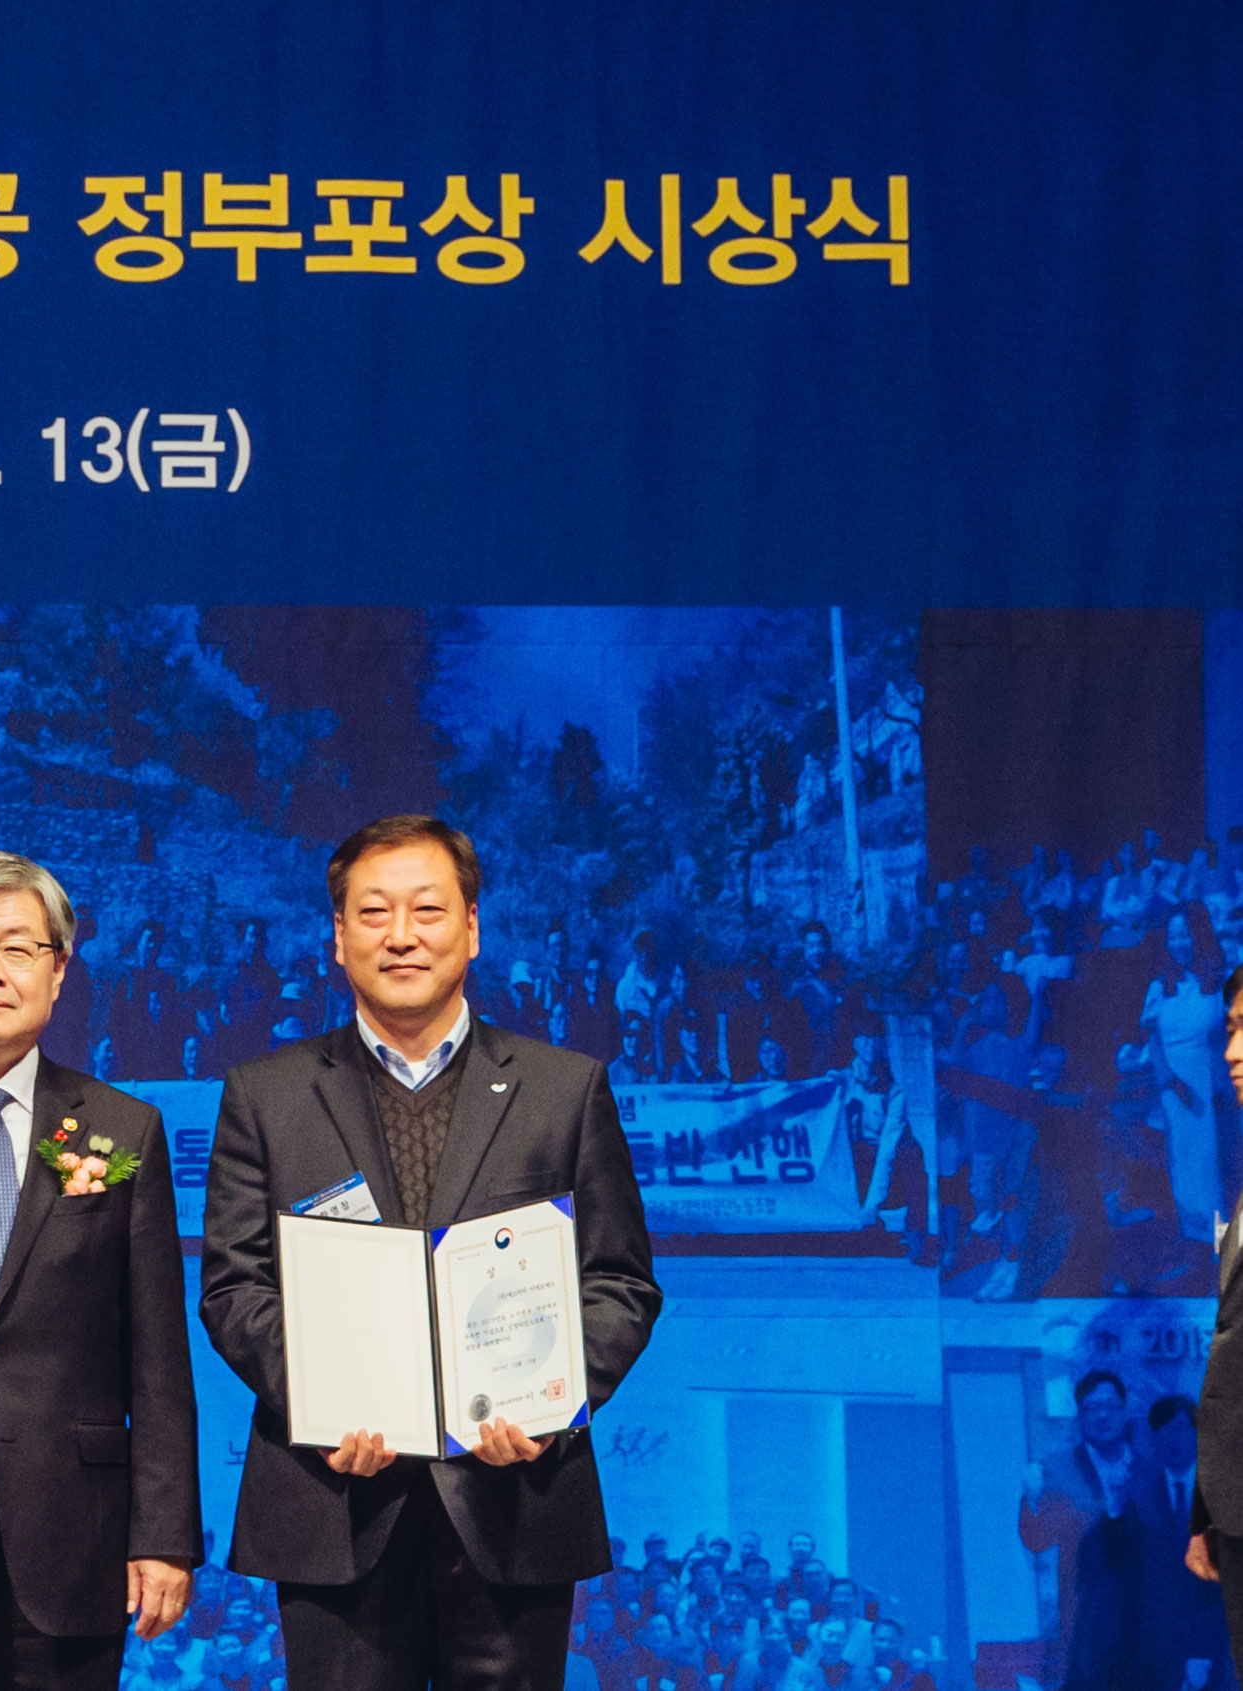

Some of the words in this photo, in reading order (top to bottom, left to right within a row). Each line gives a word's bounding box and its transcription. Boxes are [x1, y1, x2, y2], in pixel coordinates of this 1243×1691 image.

[77, 170, 535, 284] 정부포상
[578, 173, 910, 286] 시상식
[41, 407, 251, 493] 13(금)
[173, 1128, 210, 1189] 통
[724, 1122, 816, 1185] 산행
